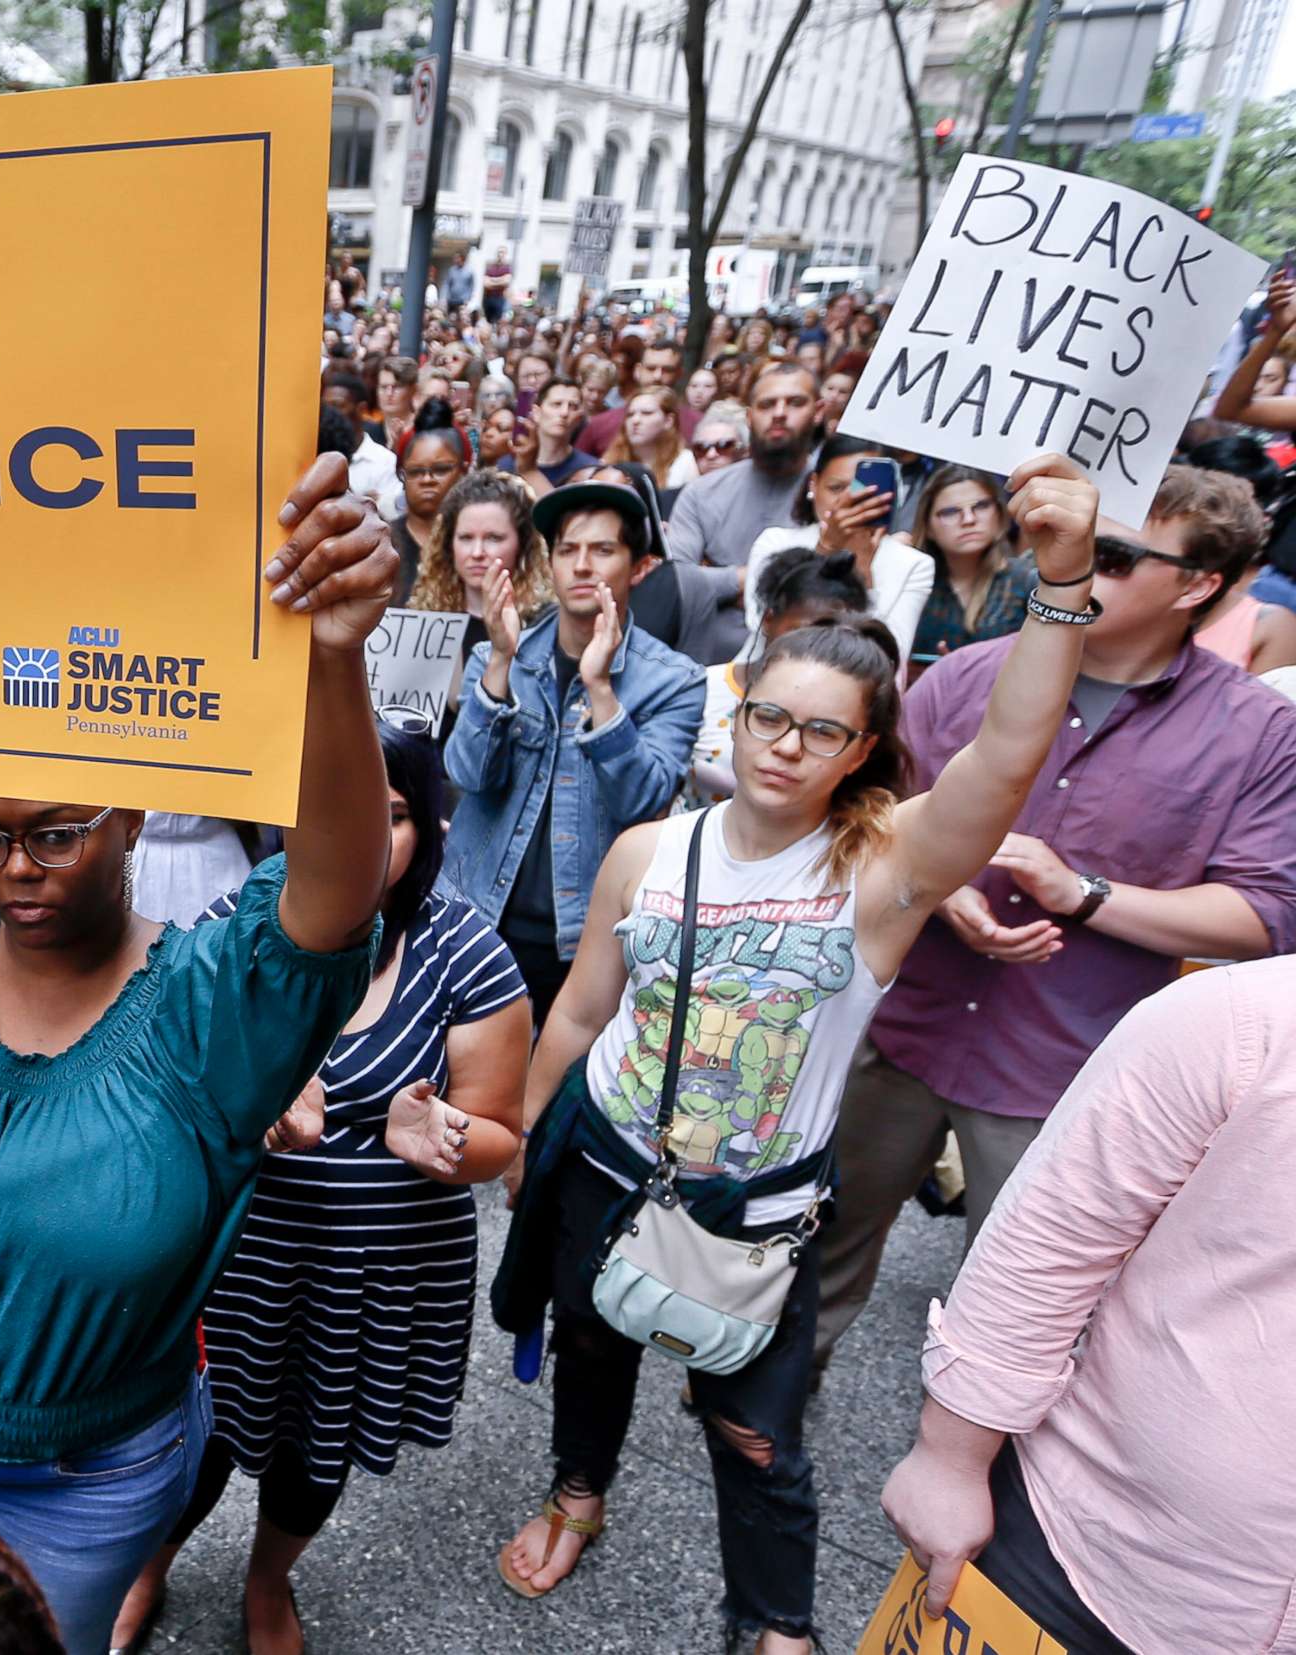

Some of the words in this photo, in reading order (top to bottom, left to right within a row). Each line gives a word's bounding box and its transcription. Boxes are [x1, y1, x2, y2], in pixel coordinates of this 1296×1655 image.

[950, 165, 1213, 306] BLACK
[908, 259, 1153, 377] LIVES
[866, 347, 1151, 487] MATTER
[1044, 609, 1073, 623] LIVES
[67, 626, 120, 648] ACLU
[367, 614, 463, 660] STICE
[66, 650, 206, 687] SMART
[66, 683, 221, 721] JUSTICE
[66, 715, 188, 740] Pennsylvania
[645, 891, 719, 925] TEENGE
[783, 898, 840, 920] NINJA
[613, 916, 856, 994] TURTLES
